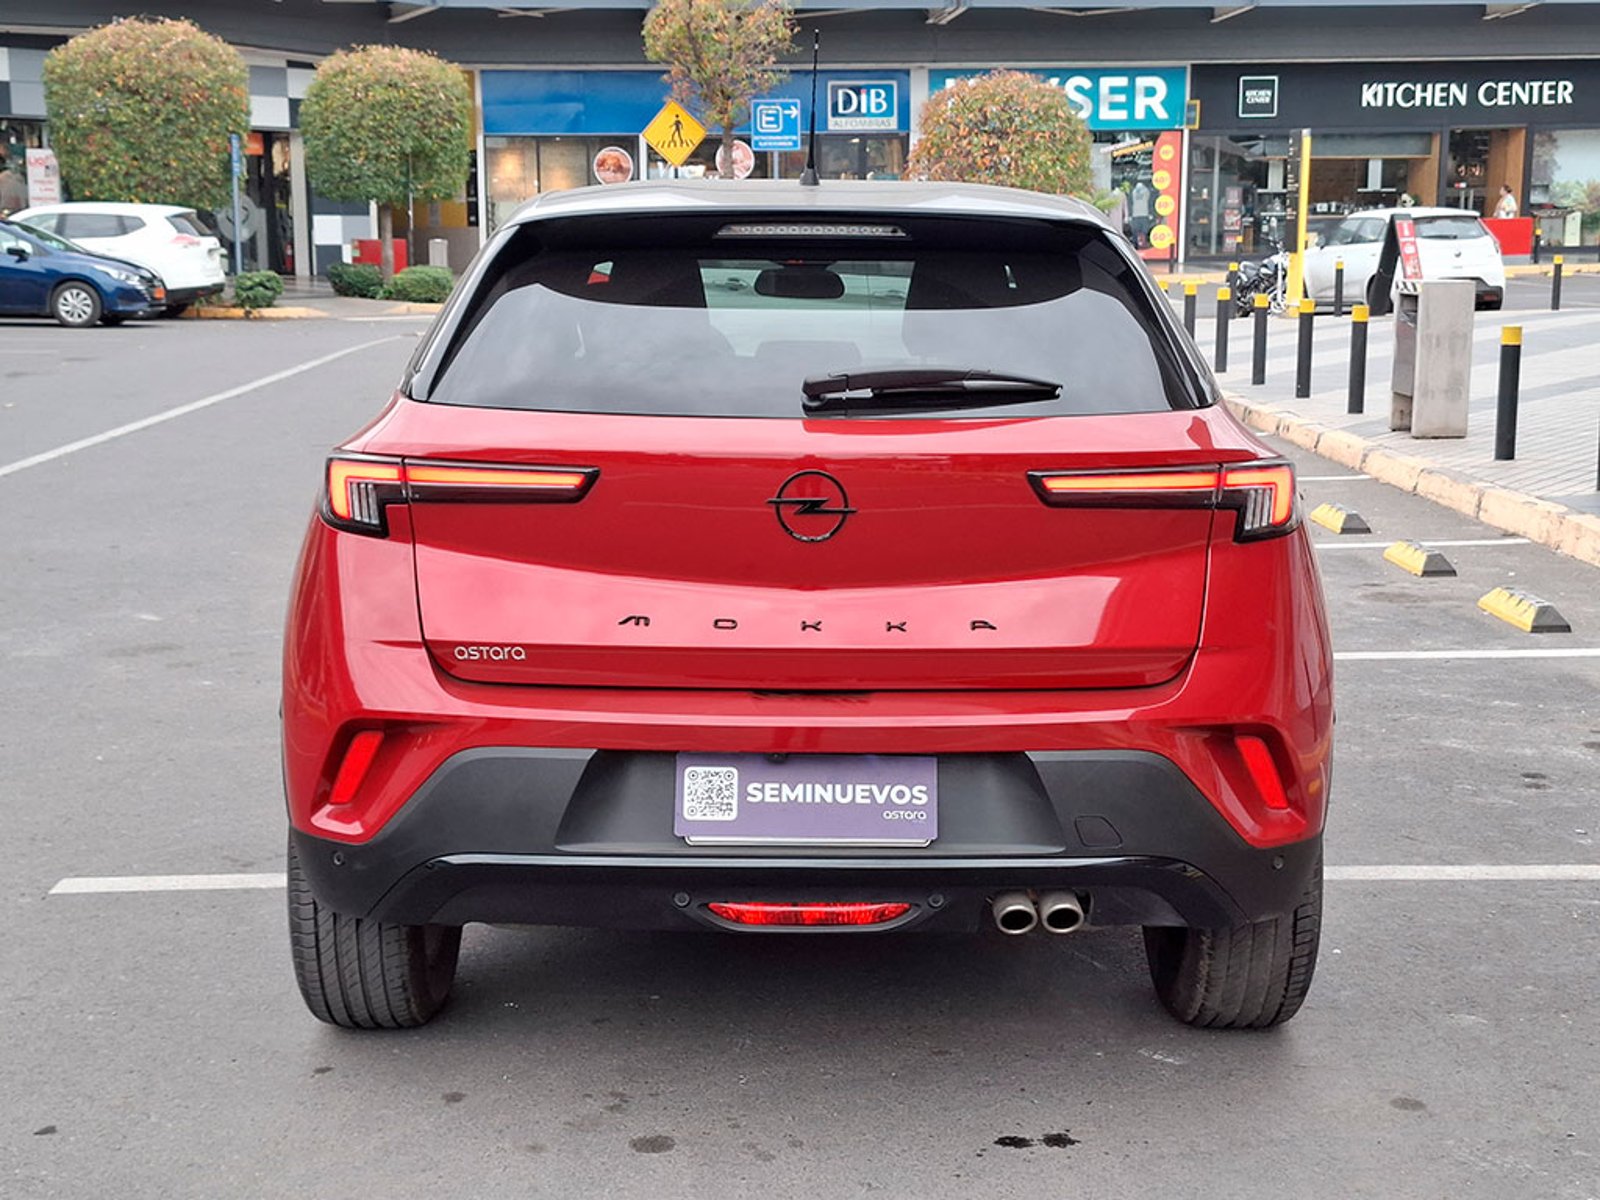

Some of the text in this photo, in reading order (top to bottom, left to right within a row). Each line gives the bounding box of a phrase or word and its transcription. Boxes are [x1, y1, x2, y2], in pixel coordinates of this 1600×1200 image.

[1361, 81, 1574, 107] KITCHEN CENTER
[762, 110, 778, 128] E
[454, 646, 527, 660] astara
[746, 782, 928, 805] SEMINUEVOS
[882, 810, 927, 820] astara
